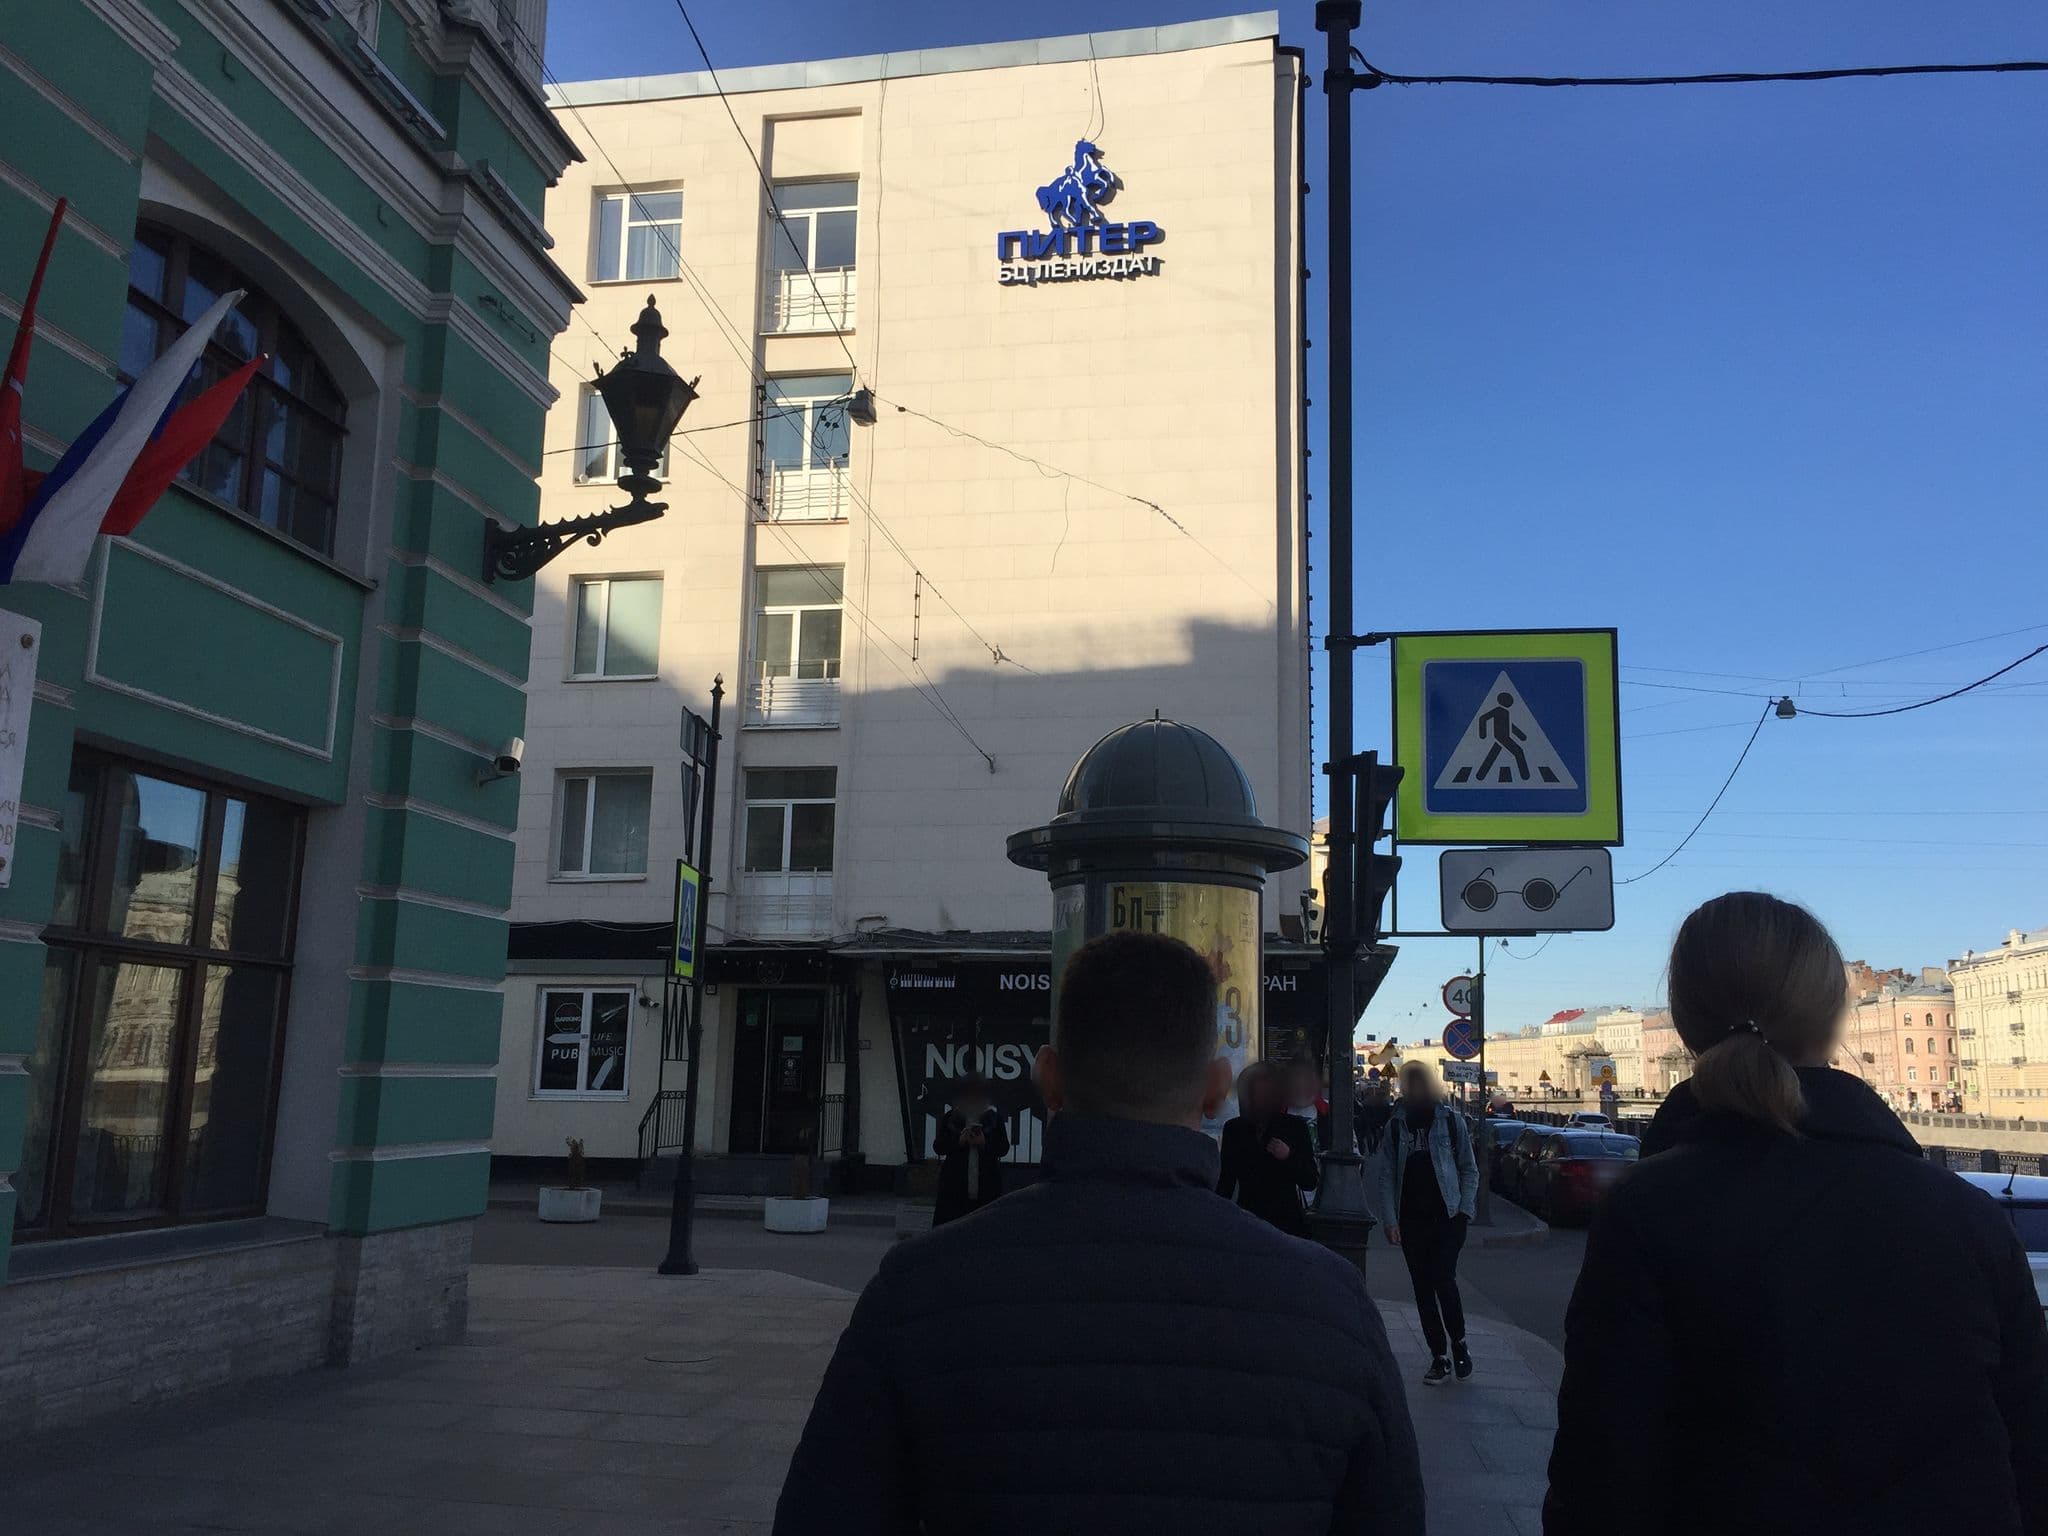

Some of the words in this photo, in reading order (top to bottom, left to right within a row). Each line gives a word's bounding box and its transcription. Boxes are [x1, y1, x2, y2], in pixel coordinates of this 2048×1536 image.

[998, 221, 1158, 260] ПИТЕР
[999, 261, 1029, 282] БЦ
[1034, 255, 1155, 279] ЛЕНИЗДАТ
[999, 973, 1051, 991] NOIS
[551, 1047, 579, 1060] PUB
[591, 1045, 625, 1057] MUSIC
[925, 1042, 1048, 1081] NOISY
